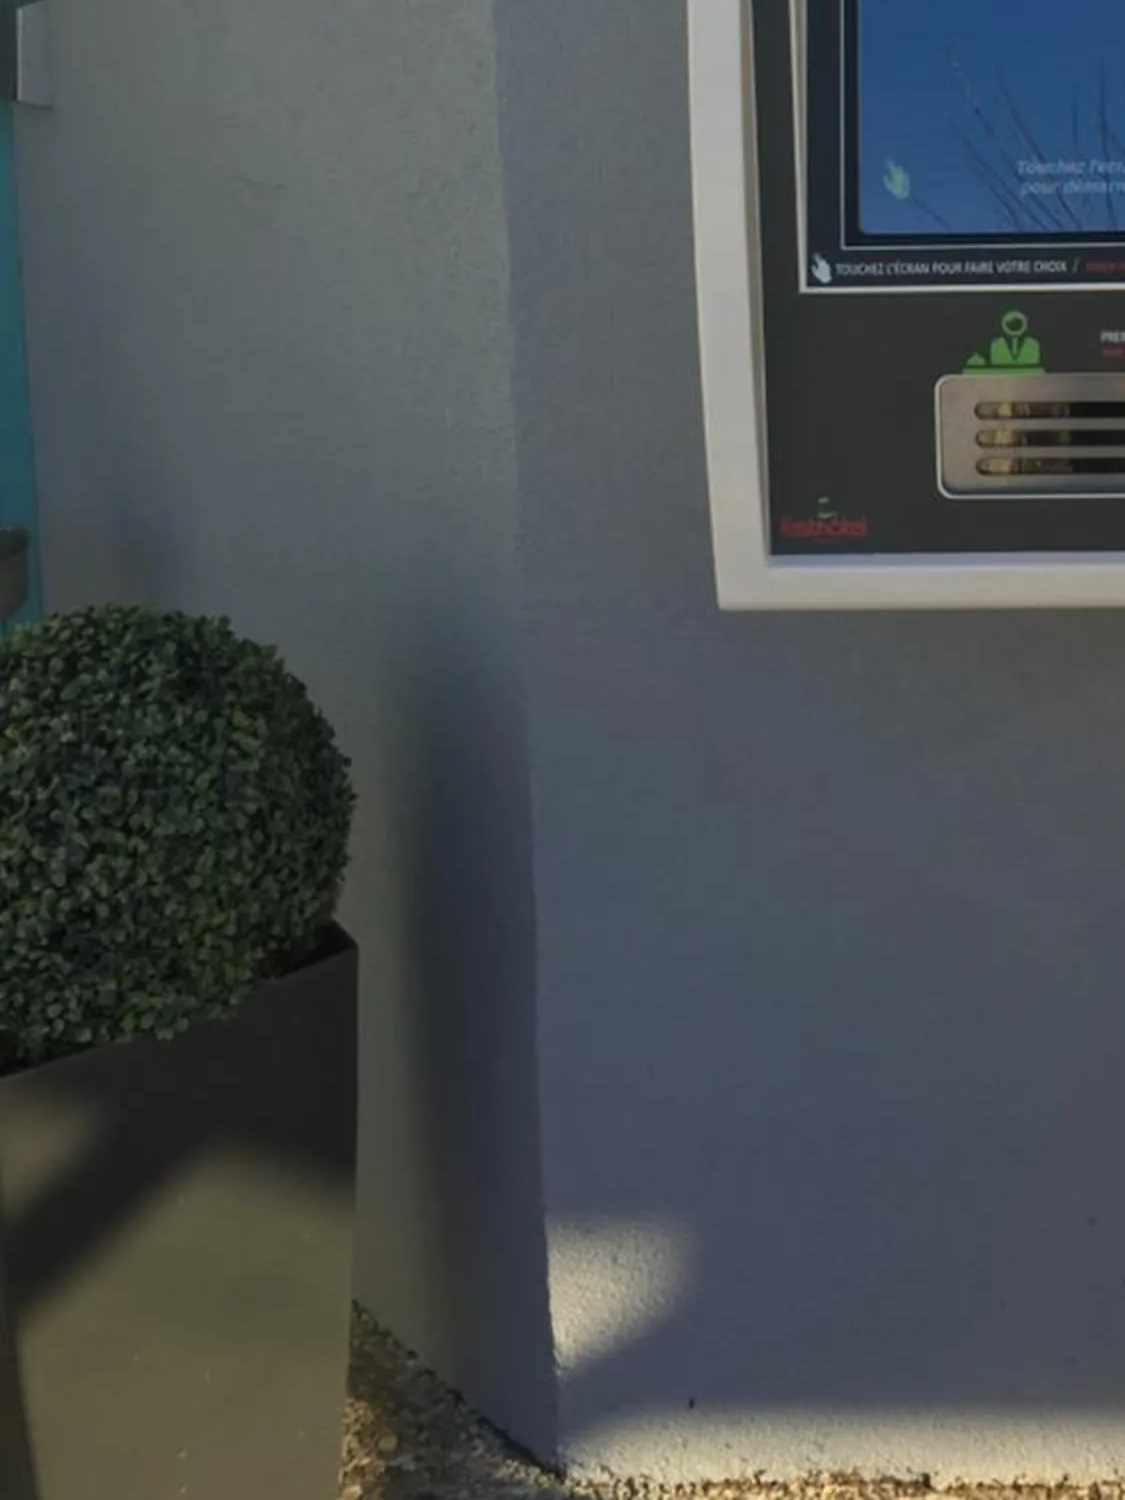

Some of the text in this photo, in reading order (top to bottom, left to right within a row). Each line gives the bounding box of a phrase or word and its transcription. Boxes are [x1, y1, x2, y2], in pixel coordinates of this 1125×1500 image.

[932, 261, 962, 275] POUR
[965, 260, 994, 274] FAIRE
[996, 260, 1031, 274] VOTRE
